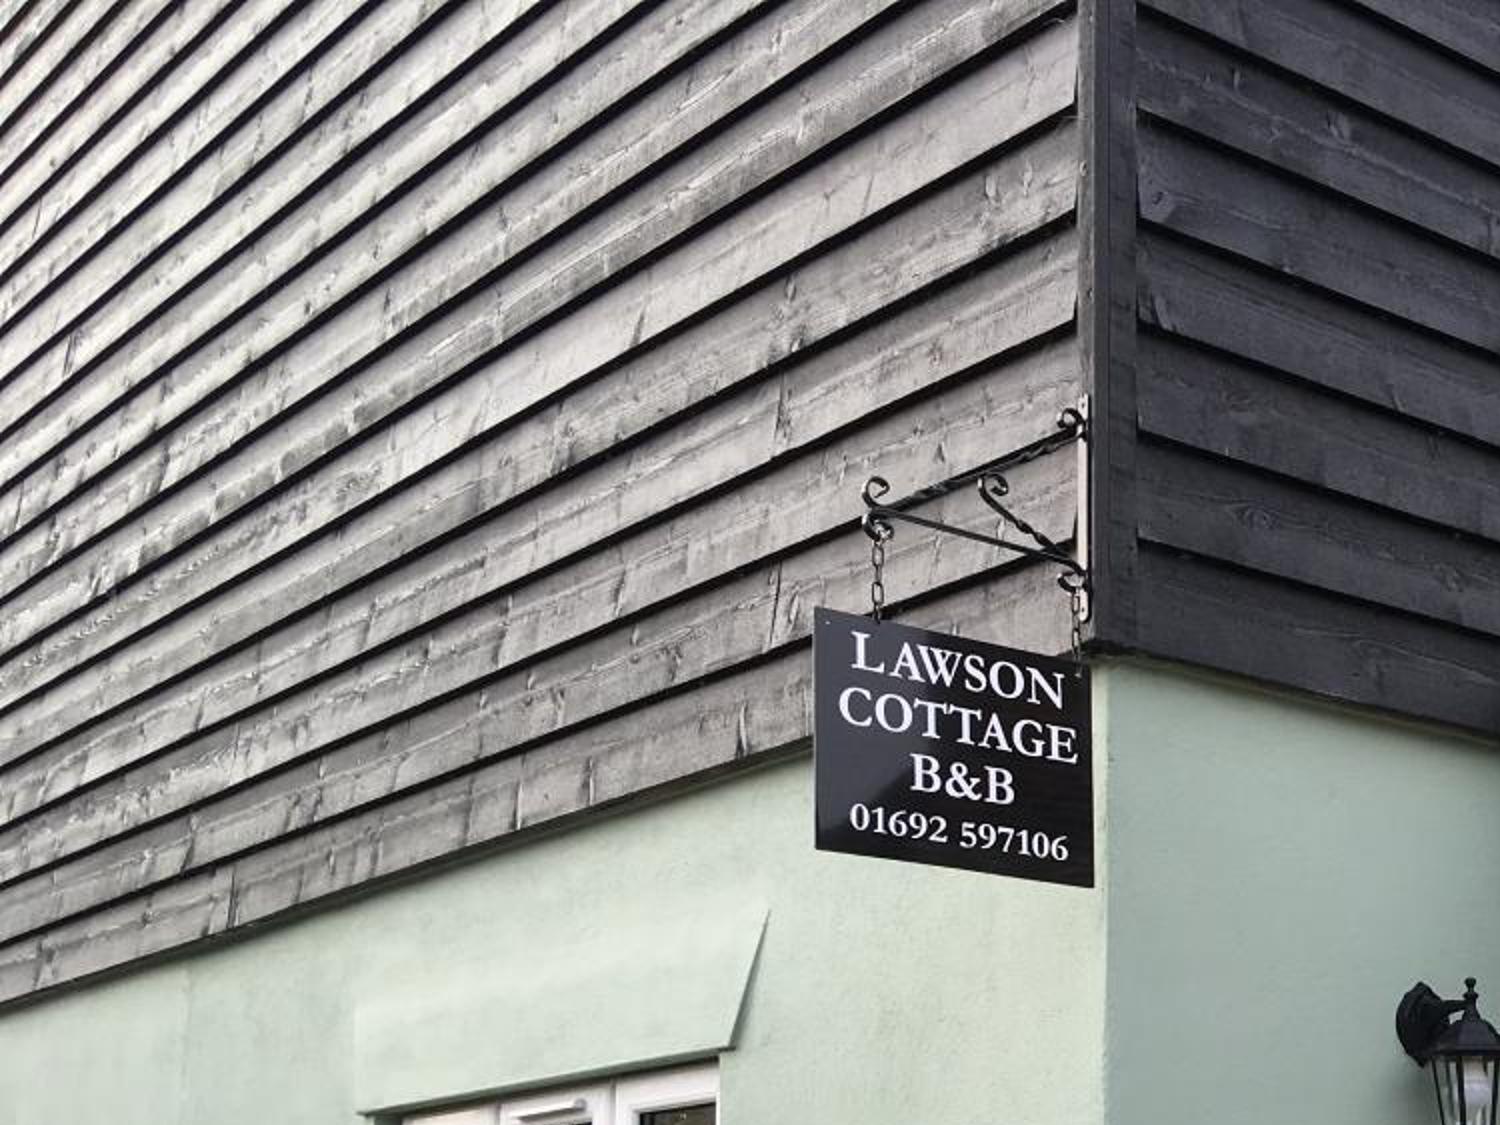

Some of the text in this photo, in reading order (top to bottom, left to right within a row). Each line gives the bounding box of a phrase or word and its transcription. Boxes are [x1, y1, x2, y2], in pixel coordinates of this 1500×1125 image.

[851, 630, 1065, 709] LAWSON
[839, 686, 1078, 764] COTTAGE
[909, 753, 1015, 805] B&B
[849, 803, 1069, 861] 01692 597106
